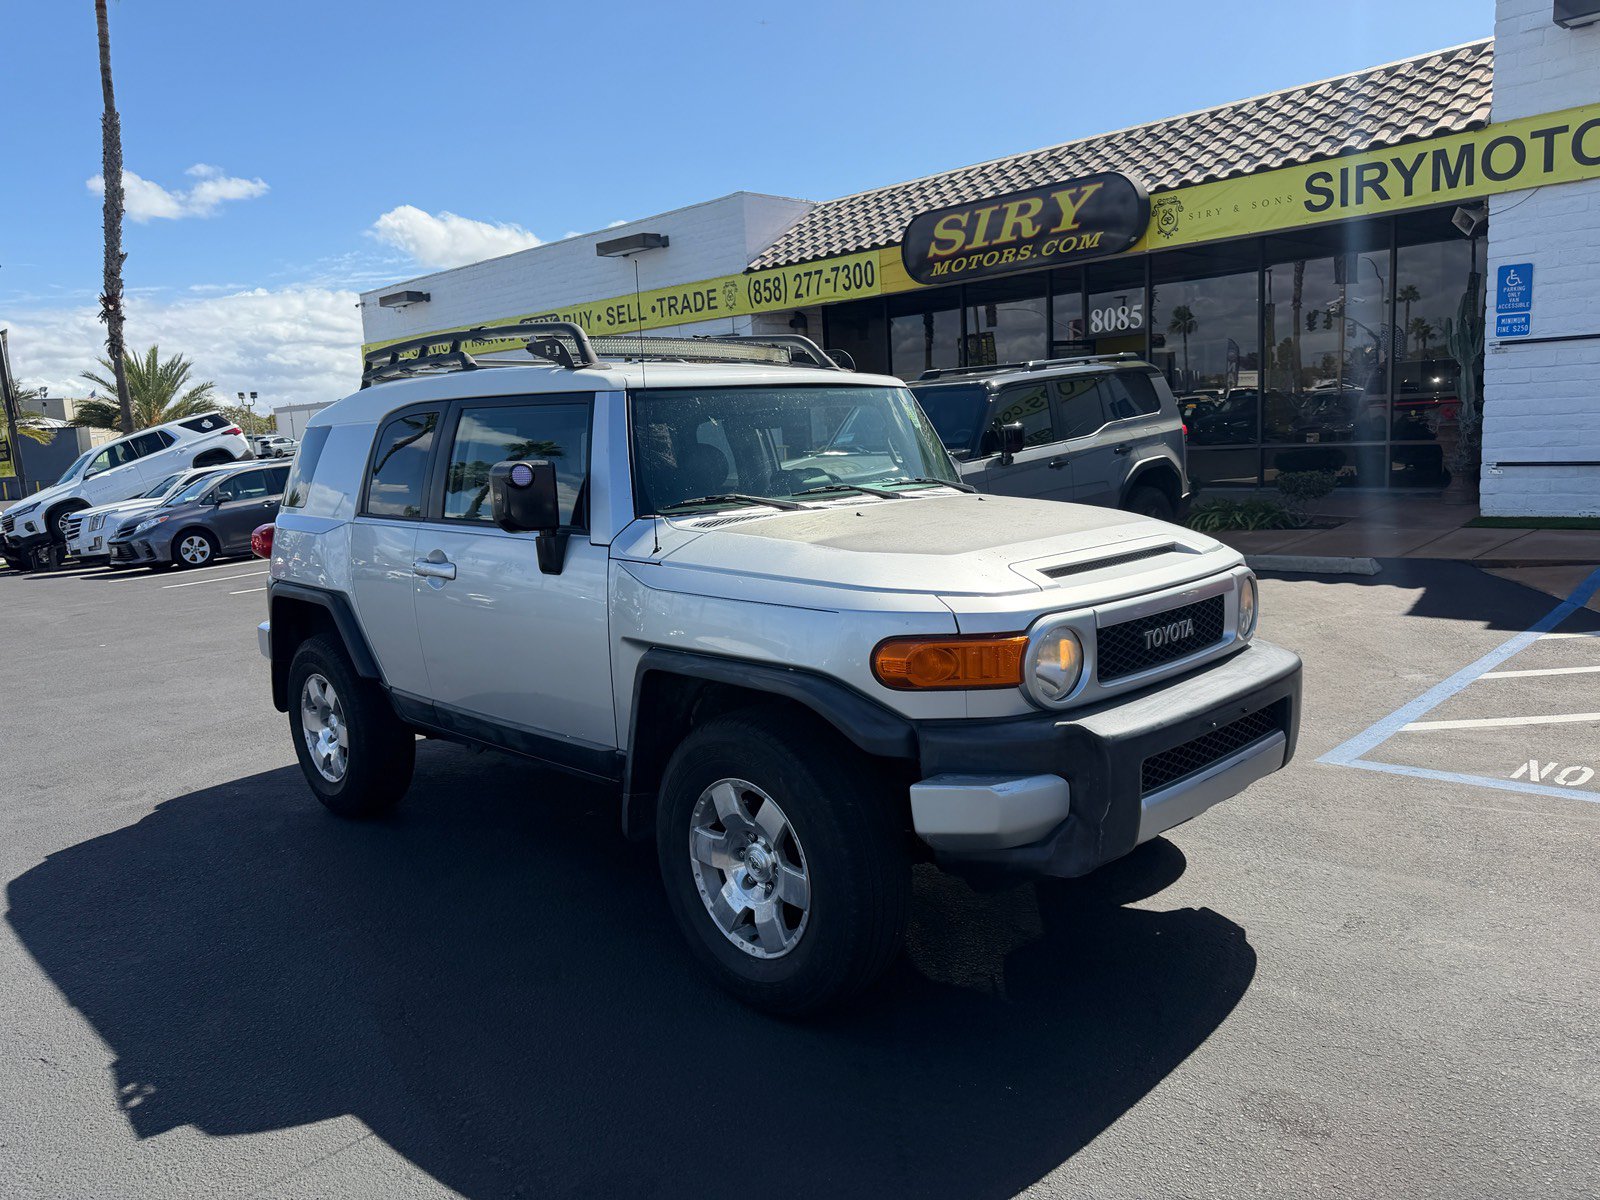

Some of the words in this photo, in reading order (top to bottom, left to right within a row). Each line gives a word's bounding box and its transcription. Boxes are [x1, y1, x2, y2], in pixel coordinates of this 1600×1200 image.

[927, 181, 1104, 258] SIRY
[1188, 207, 1222, 221] SIRY
[1233, 204, 1240, 212] &
[1251, 195, 1293, 209] SONS
[930, 231, 1104, 277] MOTORS.COM
[747, 272, 787, 309] (858)
[793, 259, 875, 299] 277-7300
[606, 302, 647, 326] SELL
[656, 288, 718, 318] TRADE
[1091, 304, 1143, 333] 8085
[1497, 325, 1509, 333] FINE
[1512, 324, 1529, 332] $250
[1144, 618, 1194, 650] TOYOTA
[1509, 759, 1595, 786] NO
